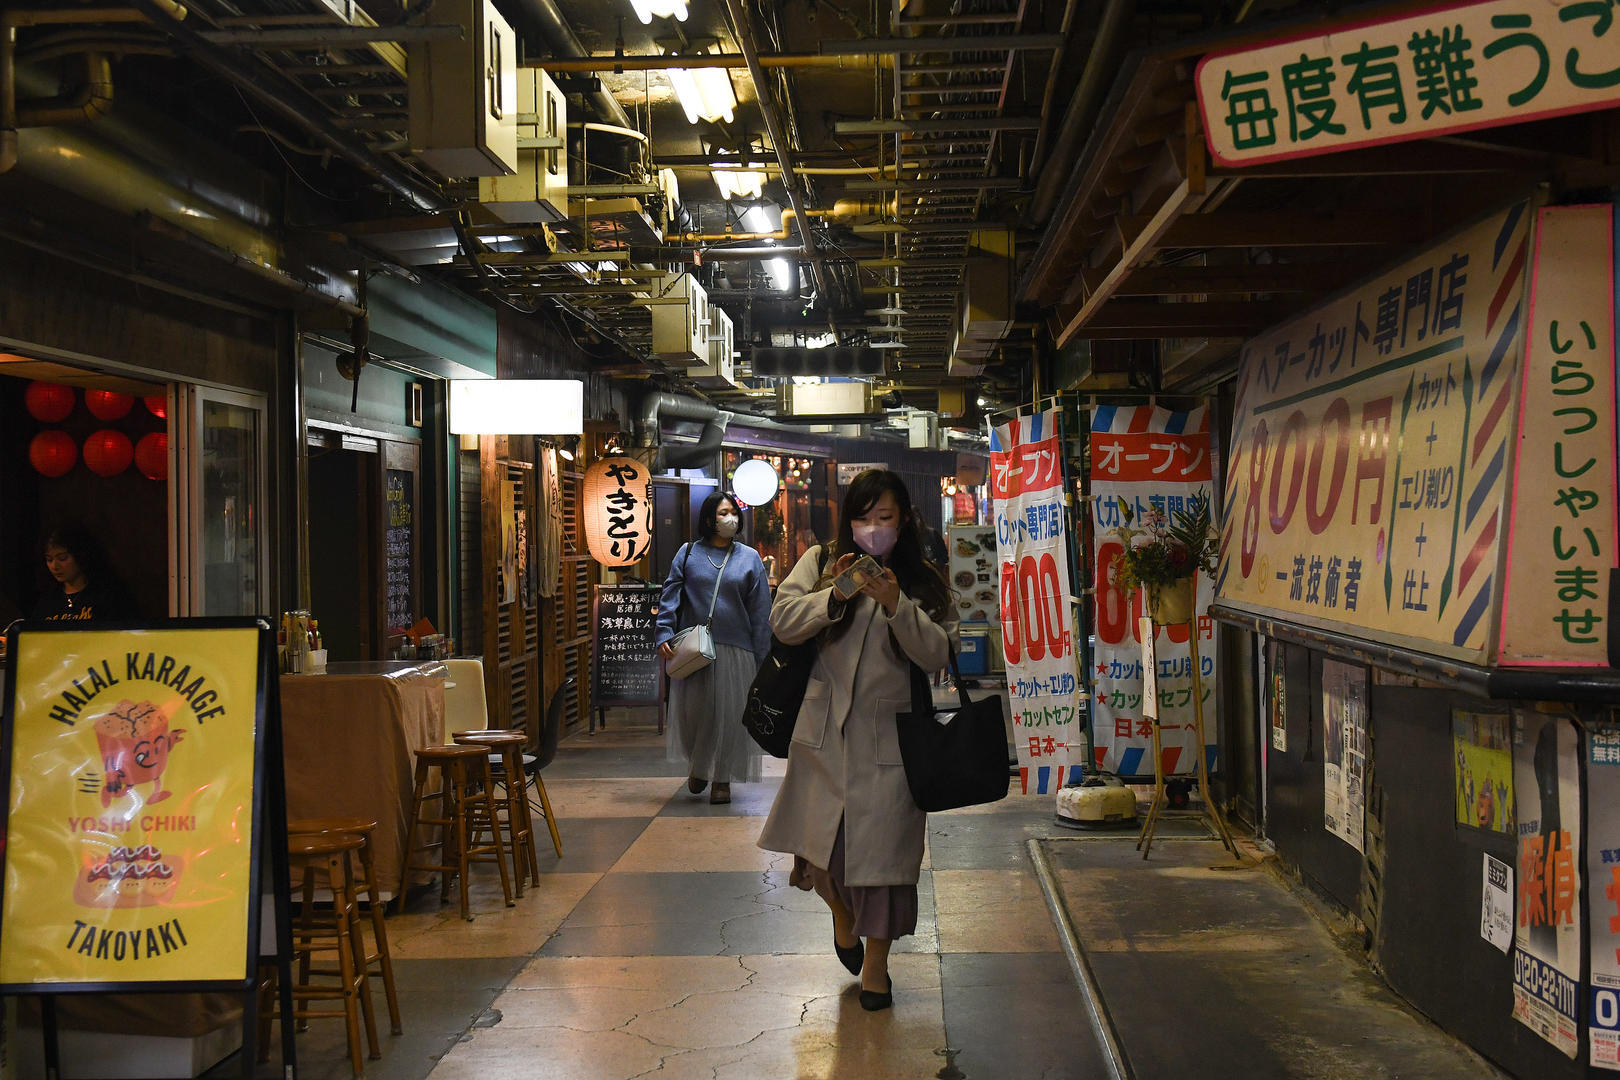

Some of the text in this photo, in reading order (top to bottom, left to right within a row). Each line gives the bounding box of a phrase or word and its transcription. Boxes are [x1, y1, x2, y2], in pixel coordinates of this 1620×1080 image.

[1256, 253, 1469, 394] ヘアーカット専門店
[1416, 362, 1457, 412] カット
[995, 448, 1056, 492] オープン
[1098, 441, 1204, 475] オープン
[605, 463, 639, 562] やきとり
[1240, 396, 1393, 579] 800円
[1276, 553, 1362, 612] 一流技術者
[1402, 569, 1429, 612] 仕上
[617, 604, 642, 613] 居酒屋
[48, 651, 226, 727] HALAL KARAAGE
[69, 815, 196, 832] YOSHI CHIKI
[1519, 829, 1575, 928] 探偵
[66, 918, 188, 961] TAKOYAKI
